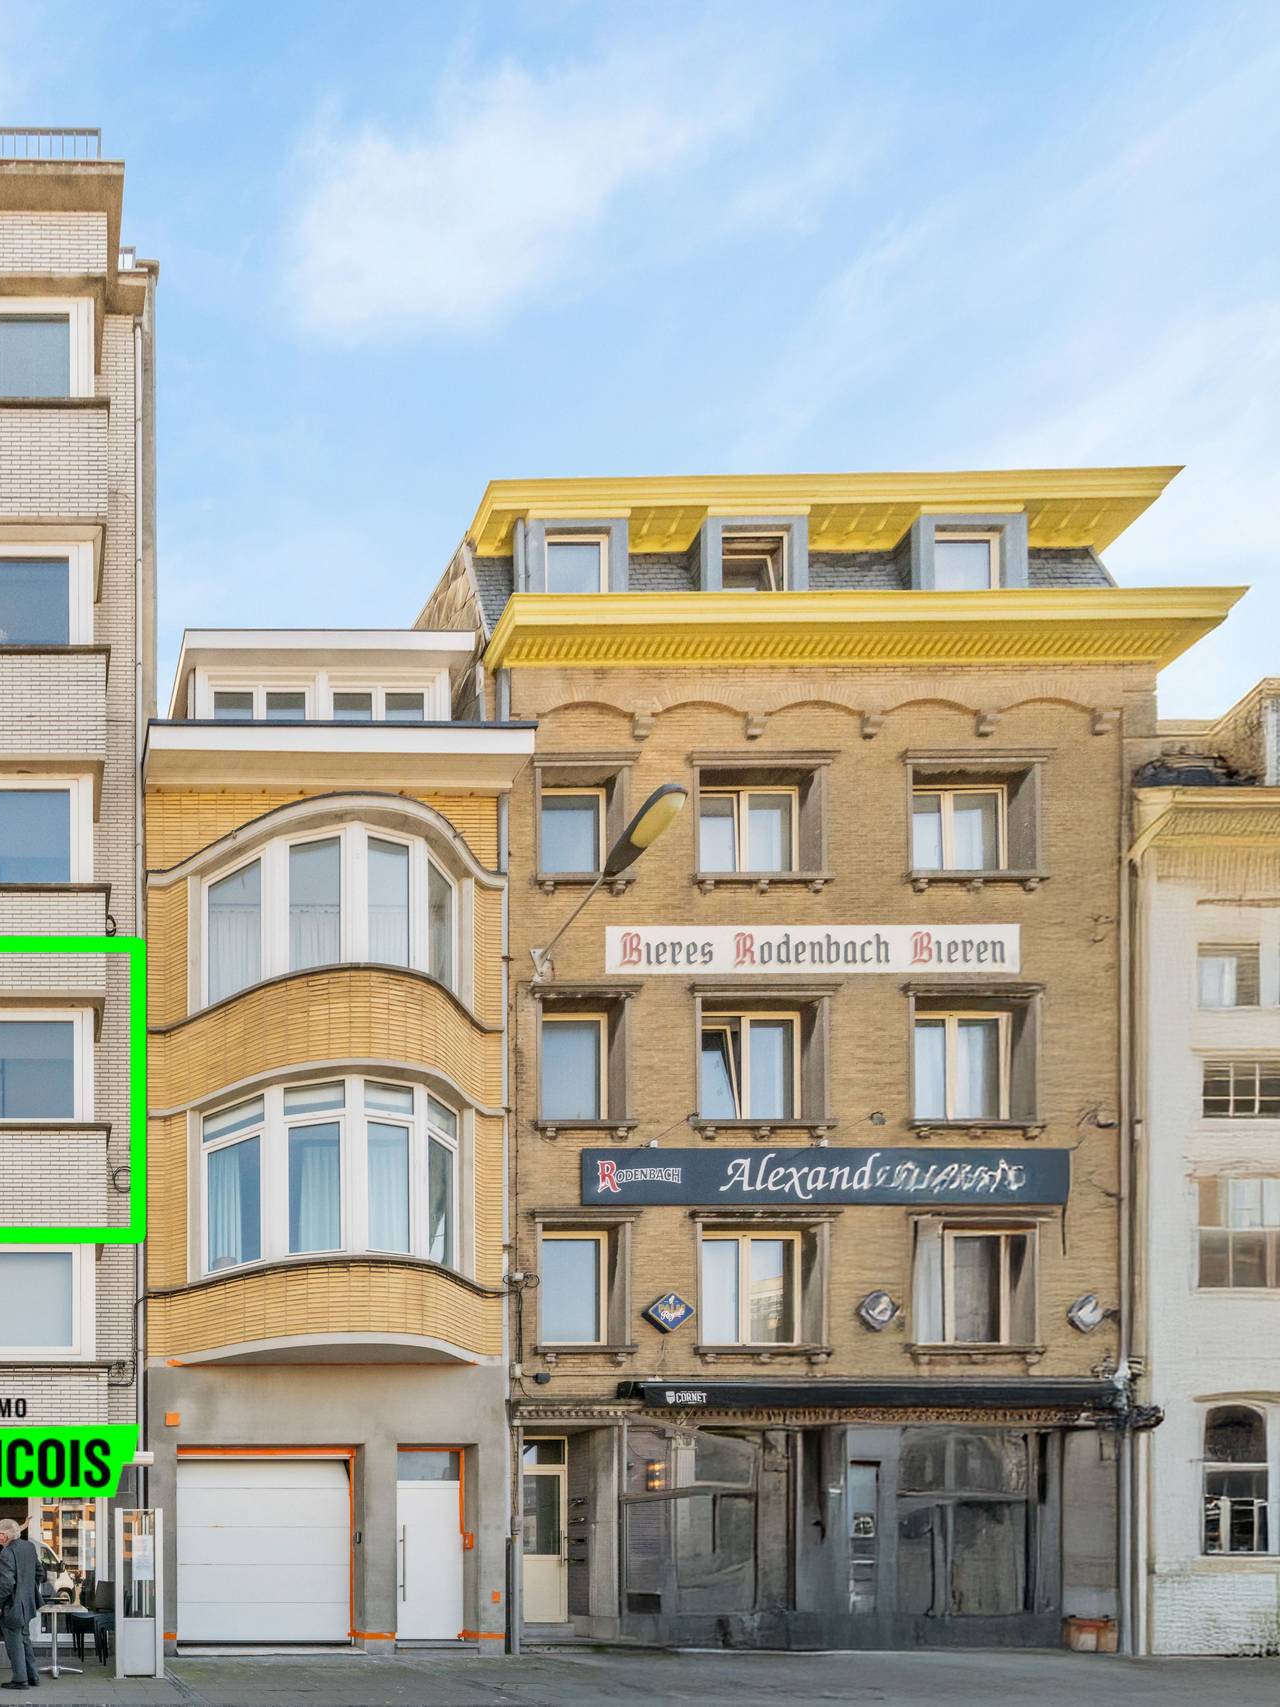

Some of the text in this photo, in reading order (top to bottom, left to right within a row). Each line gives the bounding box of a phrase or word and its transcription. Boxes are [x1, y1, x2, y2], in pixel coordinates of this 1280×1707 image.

[620, 931, 1005, 967] Bieres Rodenbach Bieren
[676, 1392, 708, 1403] CORNET
